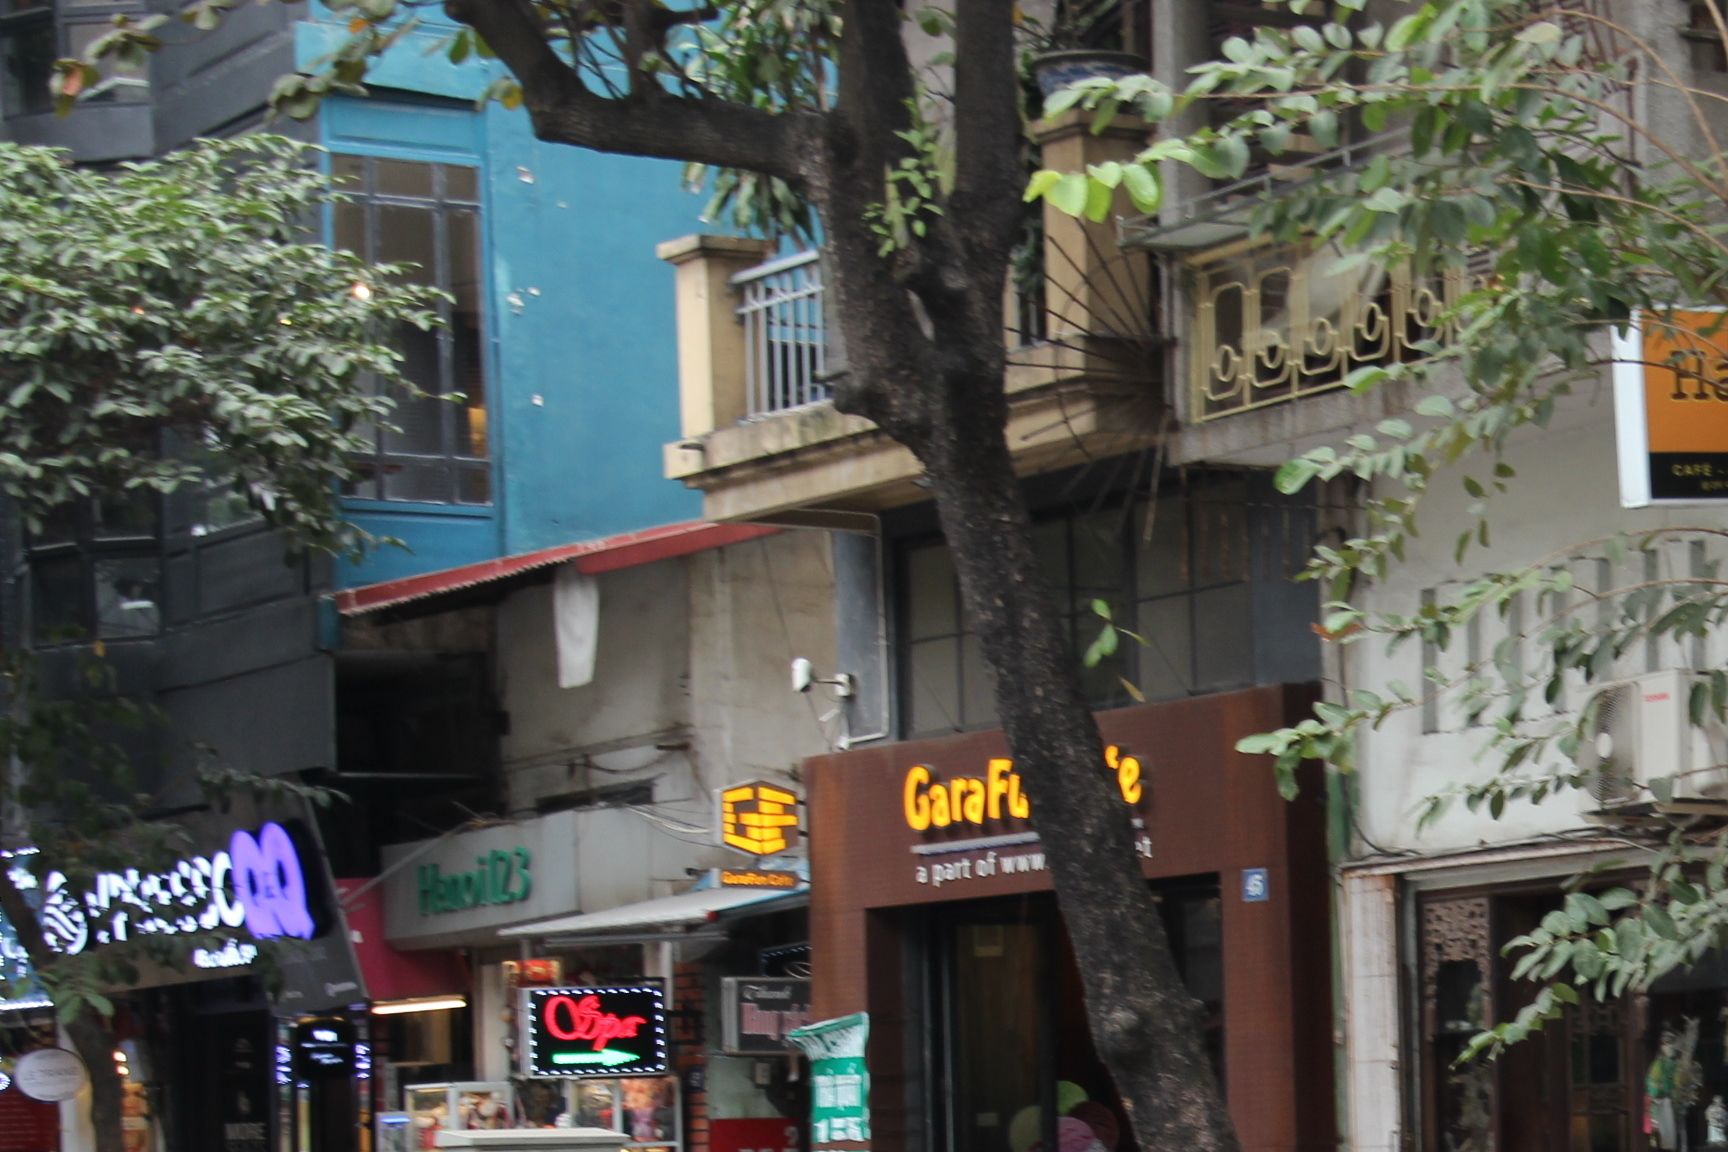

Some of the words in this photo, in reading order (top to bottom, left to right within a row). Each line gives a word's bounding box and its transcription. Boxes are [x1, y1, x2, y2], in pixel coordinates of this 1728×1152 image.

[904, 756, 1031, 832] GaraFu
[915, 865, 929, 885] a
[931, 857, 972, 888] part
[975, 851, 998, 878] of
